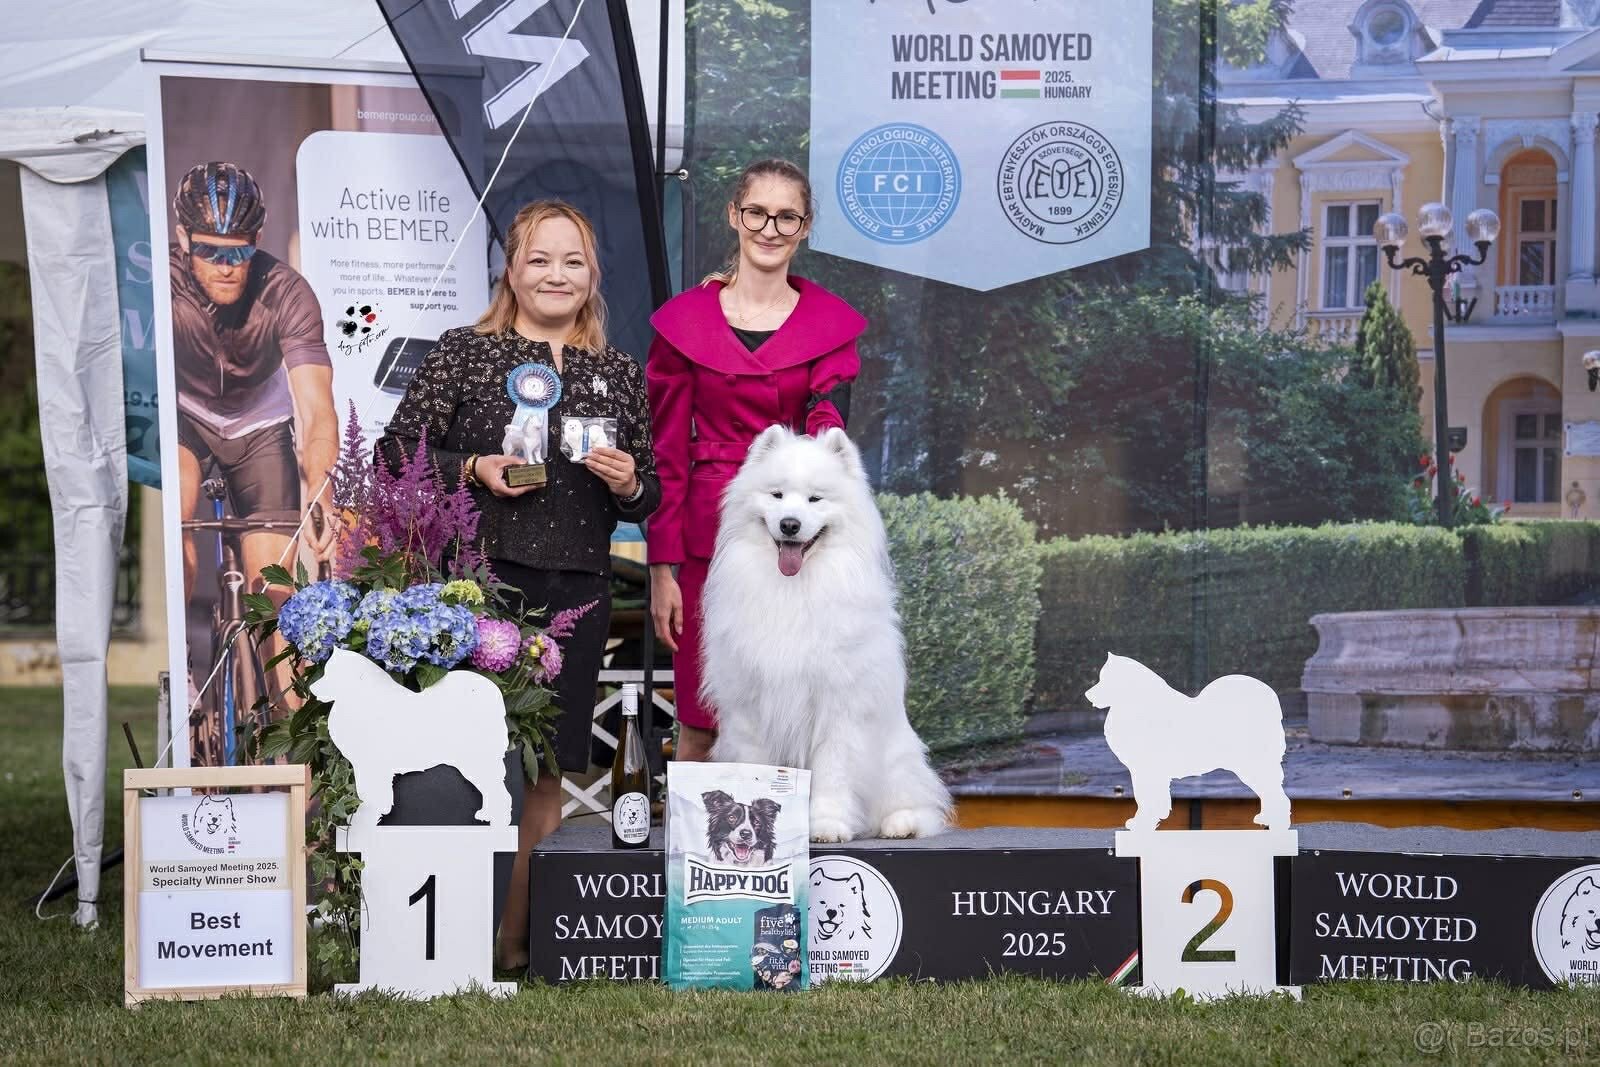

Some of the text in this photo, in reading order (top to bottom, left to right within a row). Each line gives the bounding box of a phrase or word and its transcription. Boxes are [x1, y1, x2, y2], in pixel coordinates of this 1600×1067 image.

[892, 33, 1092, 62] WORLD SAMOYED
[891, 71, 997, 100] MEETING
[1044, 71, 1074, 84] 2025.
[1044, 85, 1092, 99] HUNGARY
[843, 129, 954, 233] FEDERATION CYNOLOGIQUE INTERNATIONALE
[1008, 201, 1046, 236] MAGYAR
[1049, 126, 1107, 155] ORSZÁGOS
[339, 187, 450, 213] Active life
[1048, 206, 1073, 216] 1899
[311, 216, 455, 243] with BEMER.
[330, 259, 350, 268] More
[383, 261, 404, 270] more
[362, 273, 371, 281] of
[394, 274, 431, 283] Whatever
[332, 287, 347, 297] you
[348, 287, 356, 295] in
[387, 287, 416, 296] BEMER
[417, 287, 425, 297] is
[449, 289, 457, 298] to
[149, 862, 280, 874] World Samoyed Meeting 2025.
[689, 865, 789, 894] HAPPY DOG
[152, 874, 277, 889] Specialty Winner Show
[573, 873, 666, 898] WORL
[1335, 872, 1458, 900] WORLD
[951, 890, 1117, 916] HUNGARY
[190, 911, 241, 930] Best
[408, 874, 436, 961] 1
[554, 914, 664, 940] SAMOY
[680, 916, 743, 925] MEDIUM ADULT
[760, 915, 784, 928] five
[1180, 878, 1236, 962] 2
[1315, 912, 1477, 942] SAMOYED
[760, 928, 785, 937] healthy
[157, 938, 273, 960] Movement
[807, 950, 870, 961] ORLD SAMOYED
[1001, 932, 1067, 957] 2025
[559, 955, 662, 980] MEETI
[771, 962, 788, 970] vital
[810, 962, 838, 974] EETING
[1318, 954, 1473, 984] MEETING
[1569, 959, 1598, 971] WORLD
